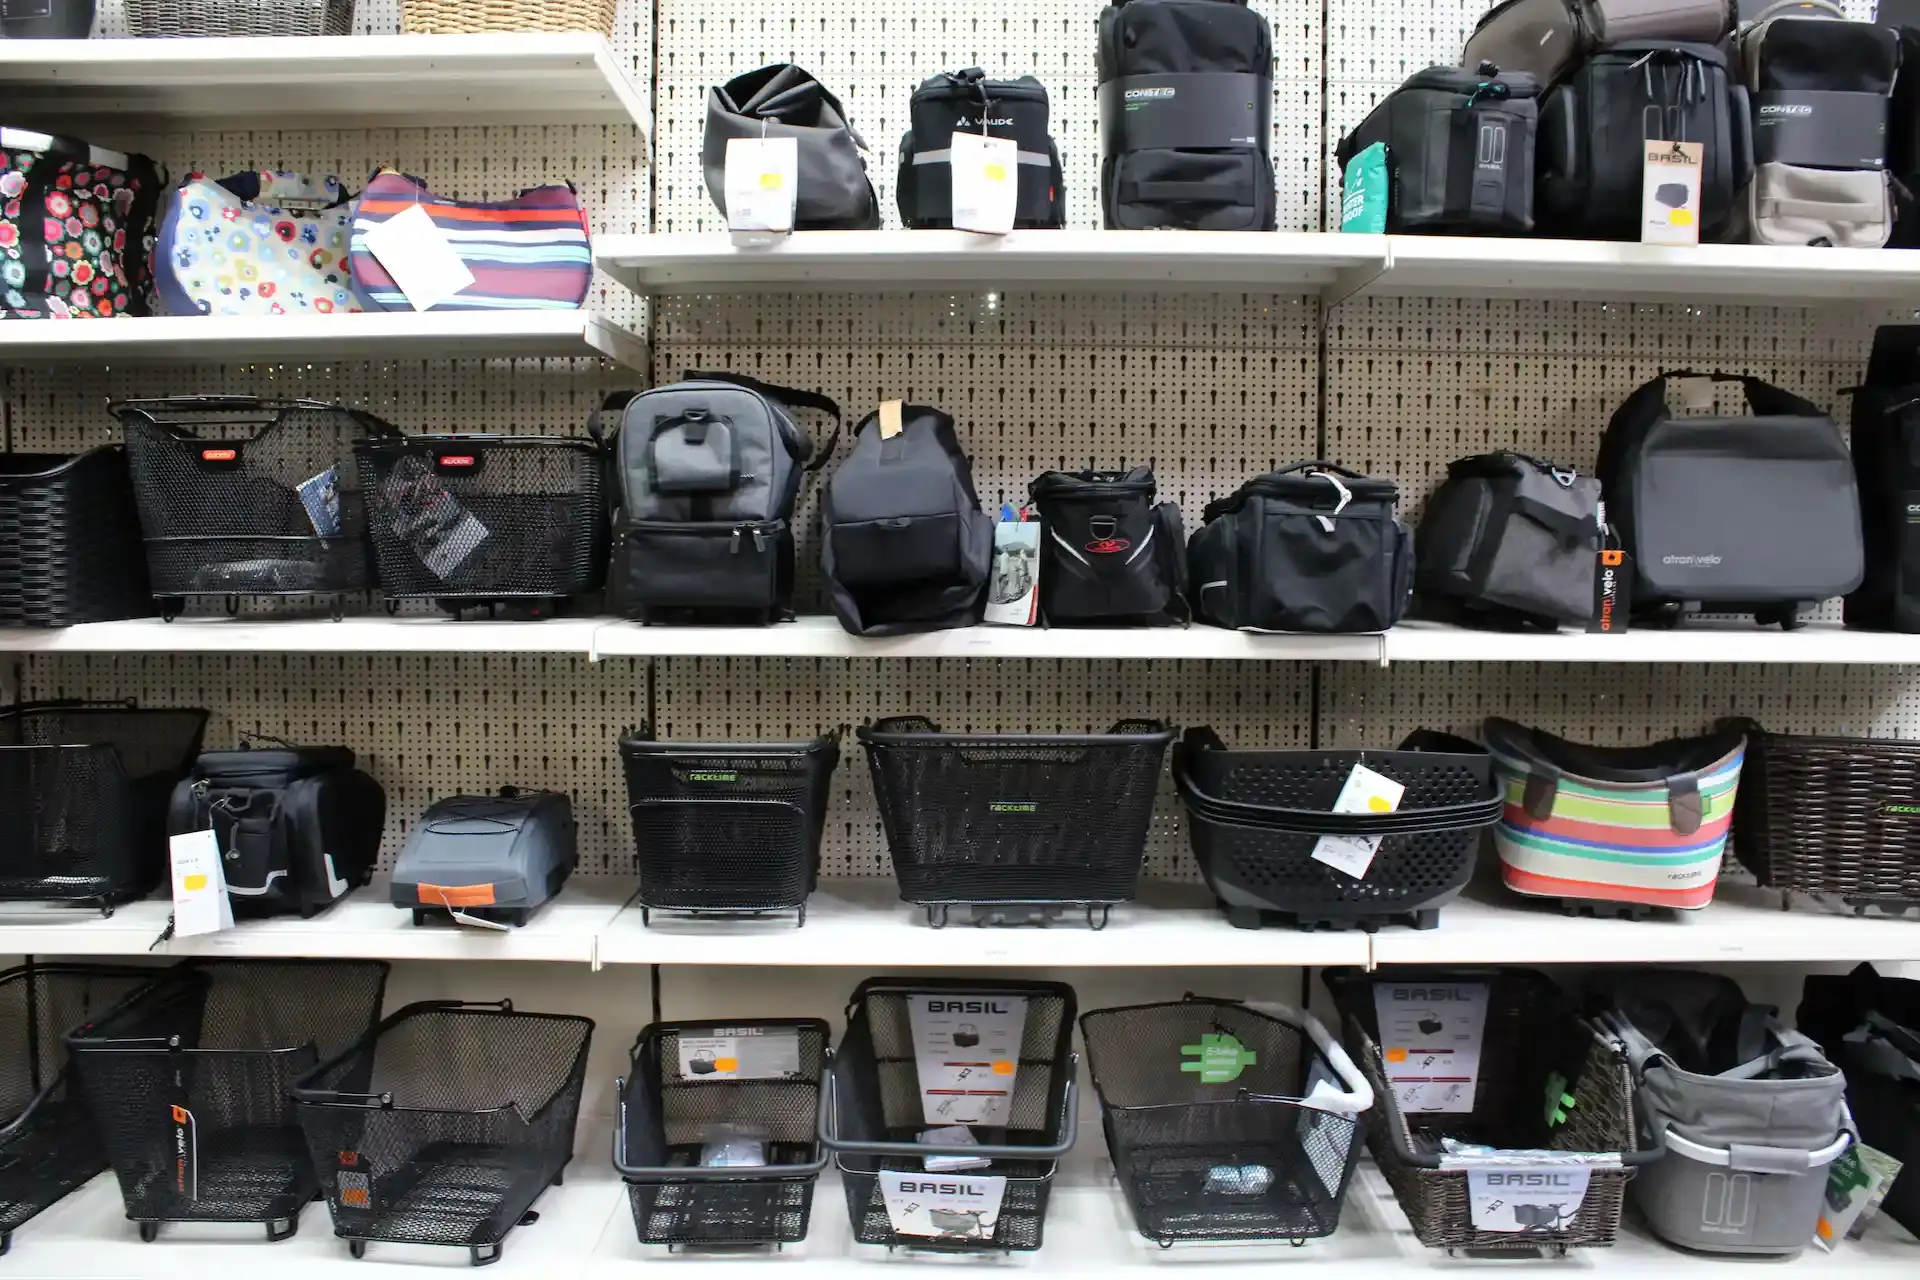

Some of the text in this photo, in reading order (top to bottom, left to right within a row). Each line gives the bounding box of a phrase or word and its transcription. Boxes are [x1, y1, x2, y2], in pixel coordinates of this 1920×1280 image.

[974, 117, 1014, 126] VAUDE
[1648, 152, 1698, 165] BASIL
[1393, 988, 1472, 1001] BASIL
[928, 1001, 1008, 1014] BASIL
[713, 1027, 764, 1036] BASIL
[1486, 1173, 1570, 1186] BASIL
[899, 1181, 984, 1196] BASIL
